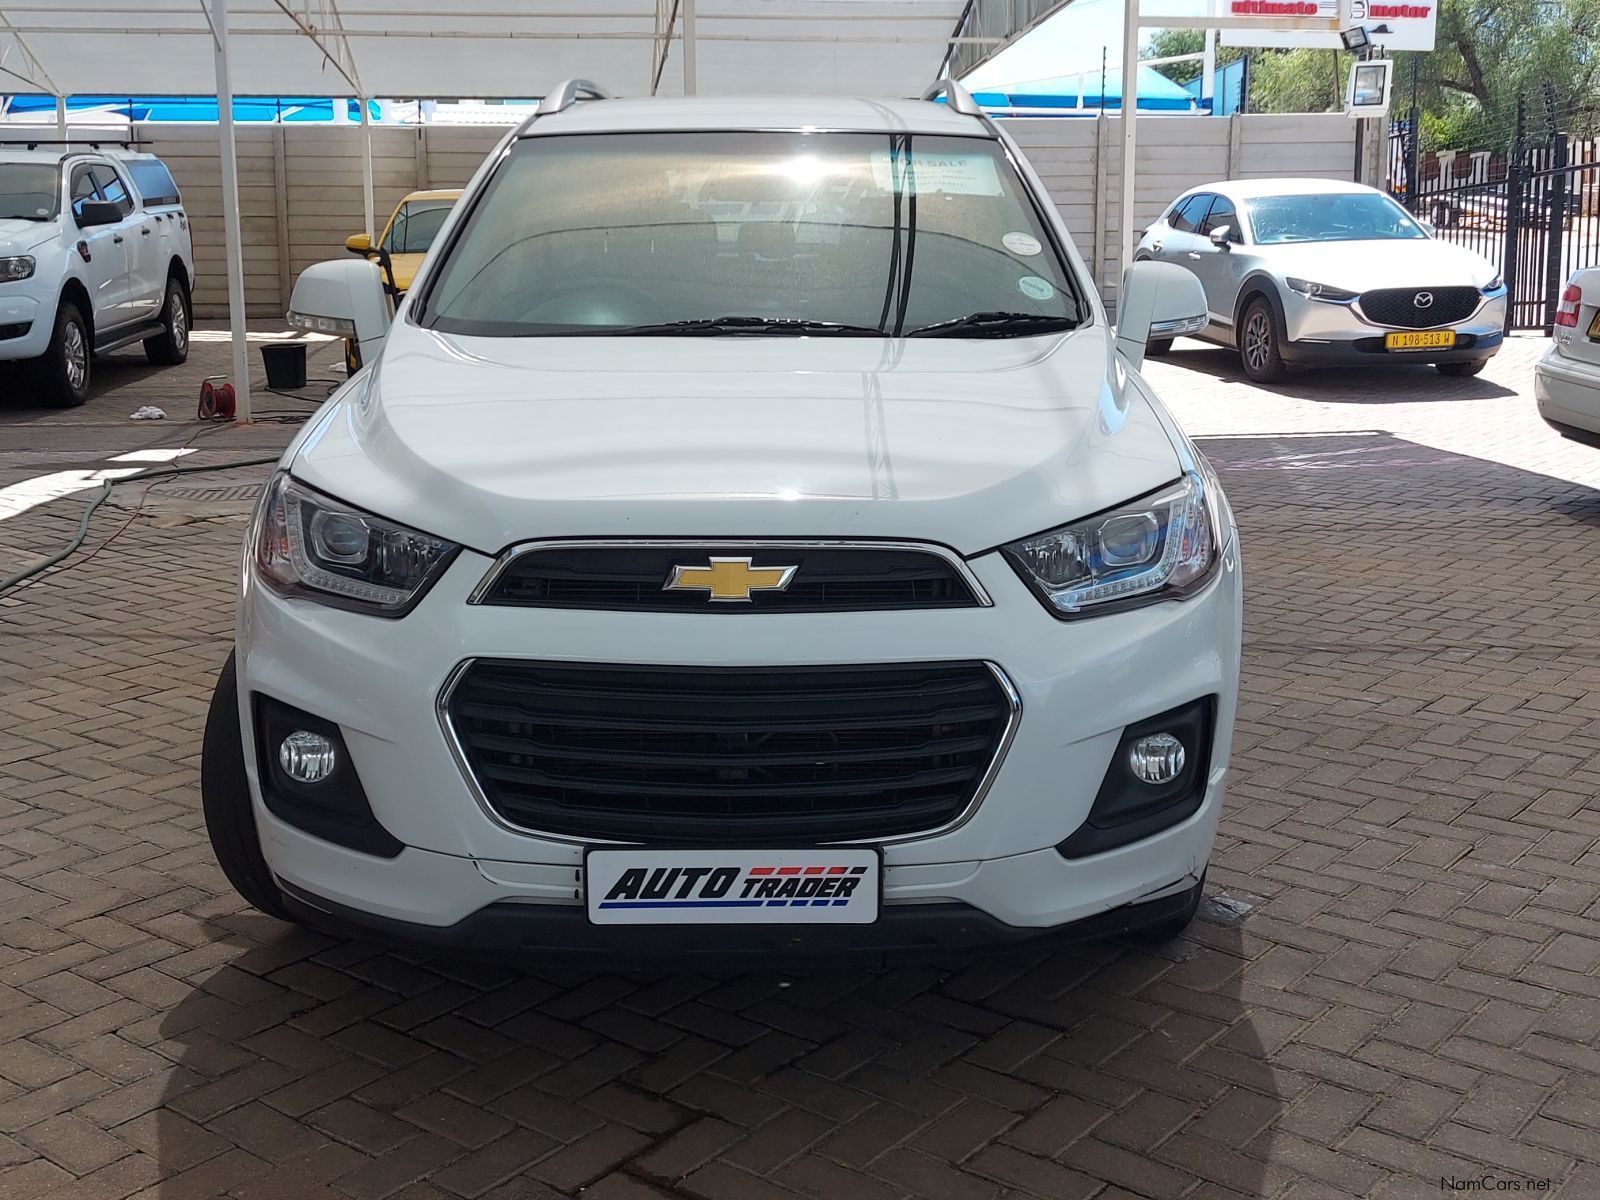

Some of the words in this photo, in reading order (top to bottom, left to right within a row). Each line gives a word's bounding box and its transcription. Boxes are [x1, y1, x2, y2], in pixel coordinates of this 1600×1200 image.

[1231, 1, 1318, 15] ultimate
[1369, 5, 1431, 18] motor
[1392, 335, 1399, 347] N
[1402, 334, 1441, 346] 198-513
[603, 867, 741, 900] AUTO
[739, 877, 861, 898] TRADER
